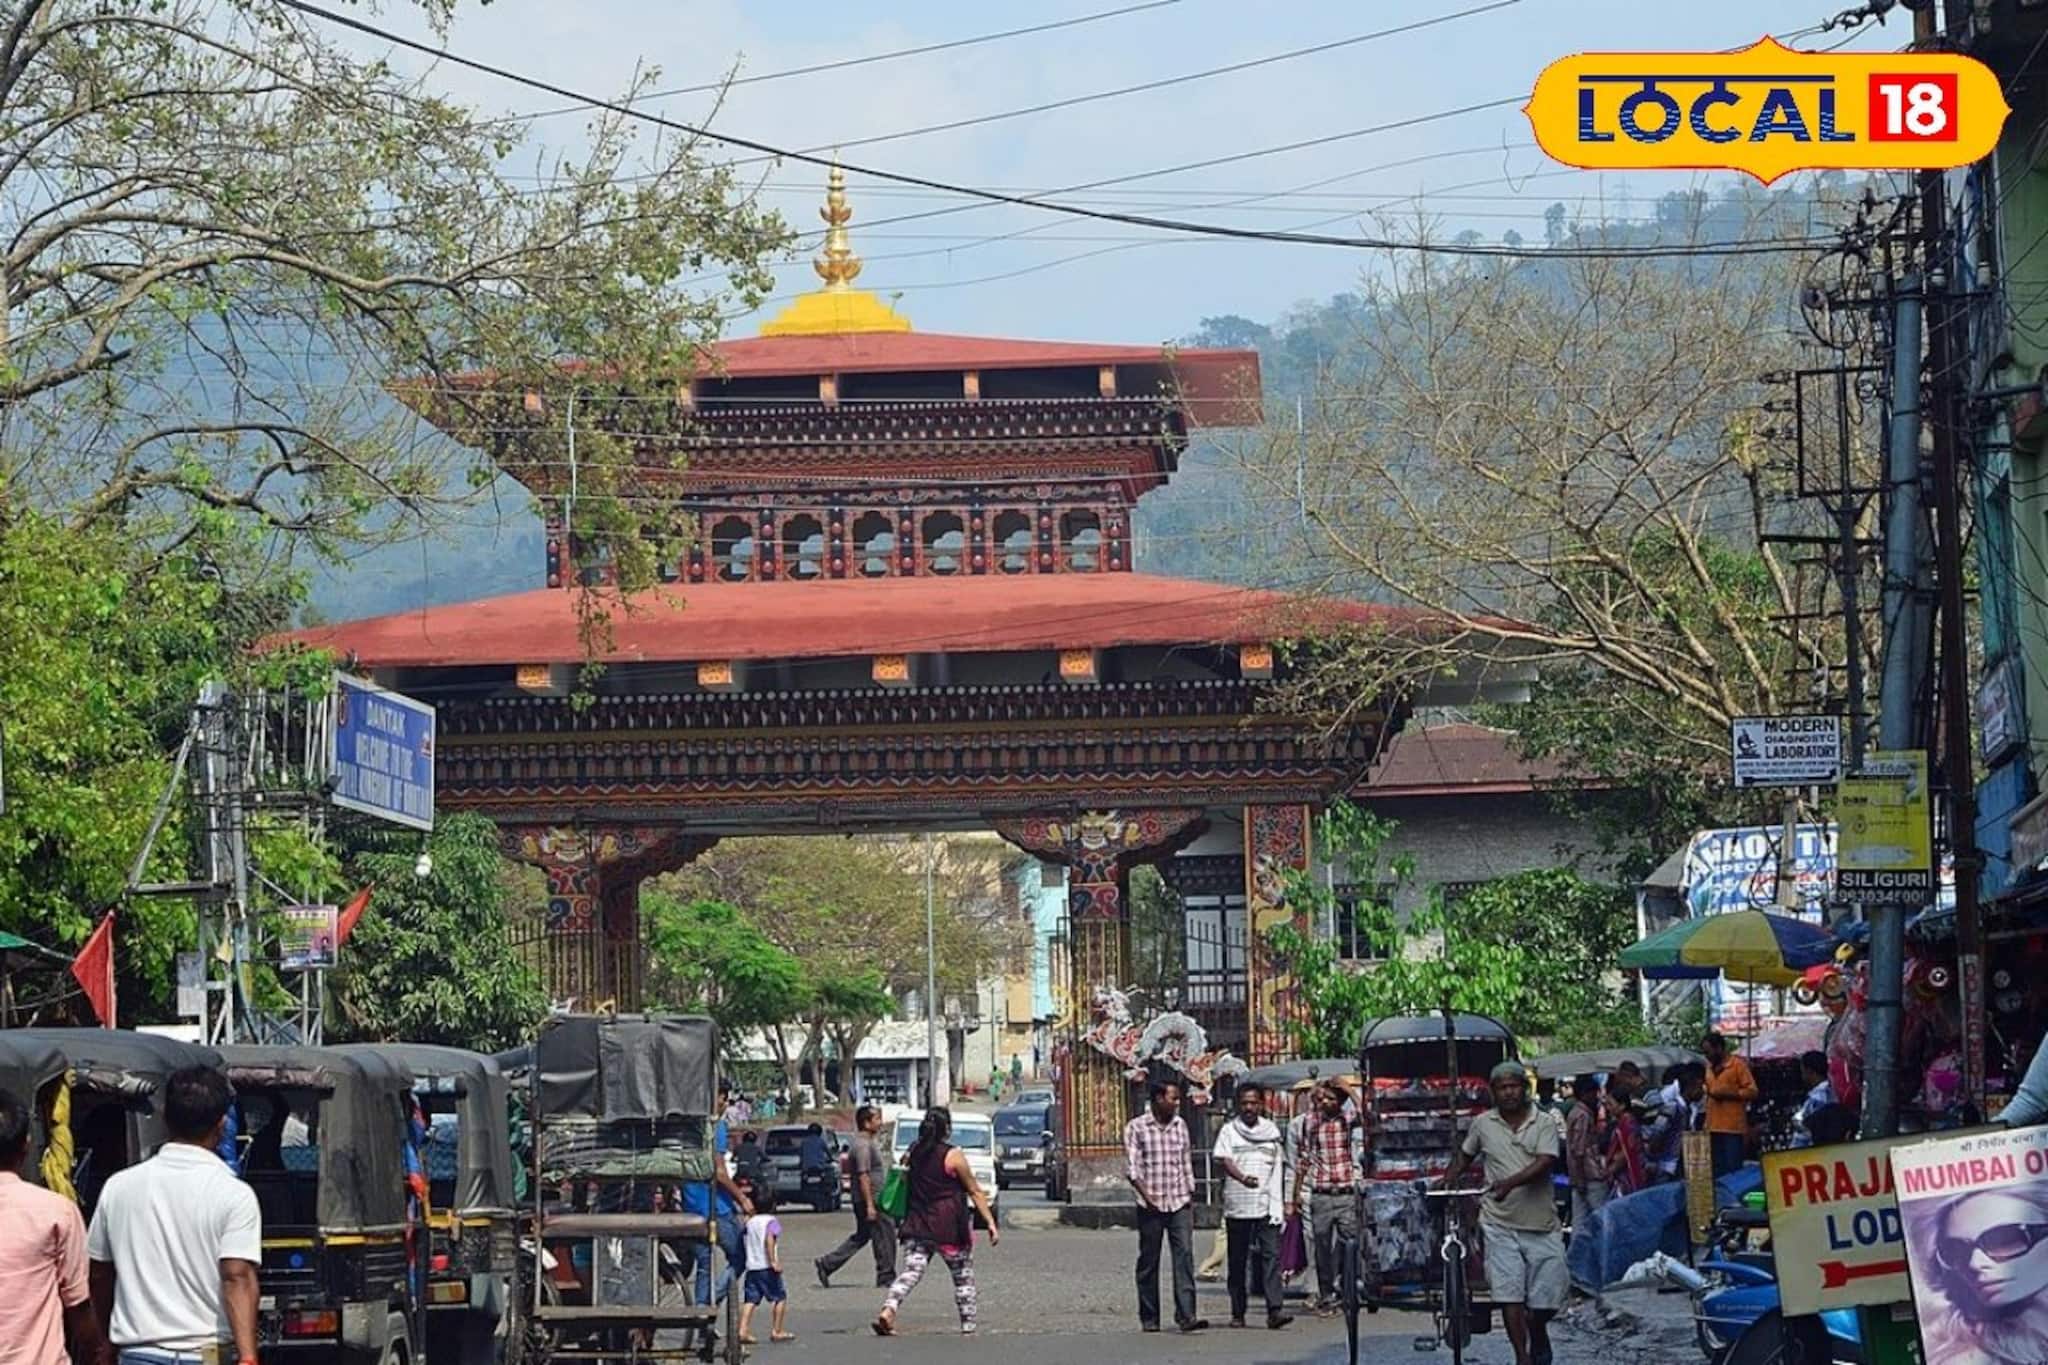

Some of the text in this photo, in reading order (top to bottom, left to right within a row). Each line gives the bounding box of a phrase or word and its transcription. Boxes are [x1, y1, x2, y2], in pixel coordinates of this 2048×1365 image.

[1765, 719, 1835, 733] MODERN
[1765, 734, 1836, 744] DIAGNOSTC
[1765, 745, 1837, 759] LABORATORY
[1841, 872, 1927, 888] SILIGURI
[1904, 1154, 2016, 1193] MUMBAI
